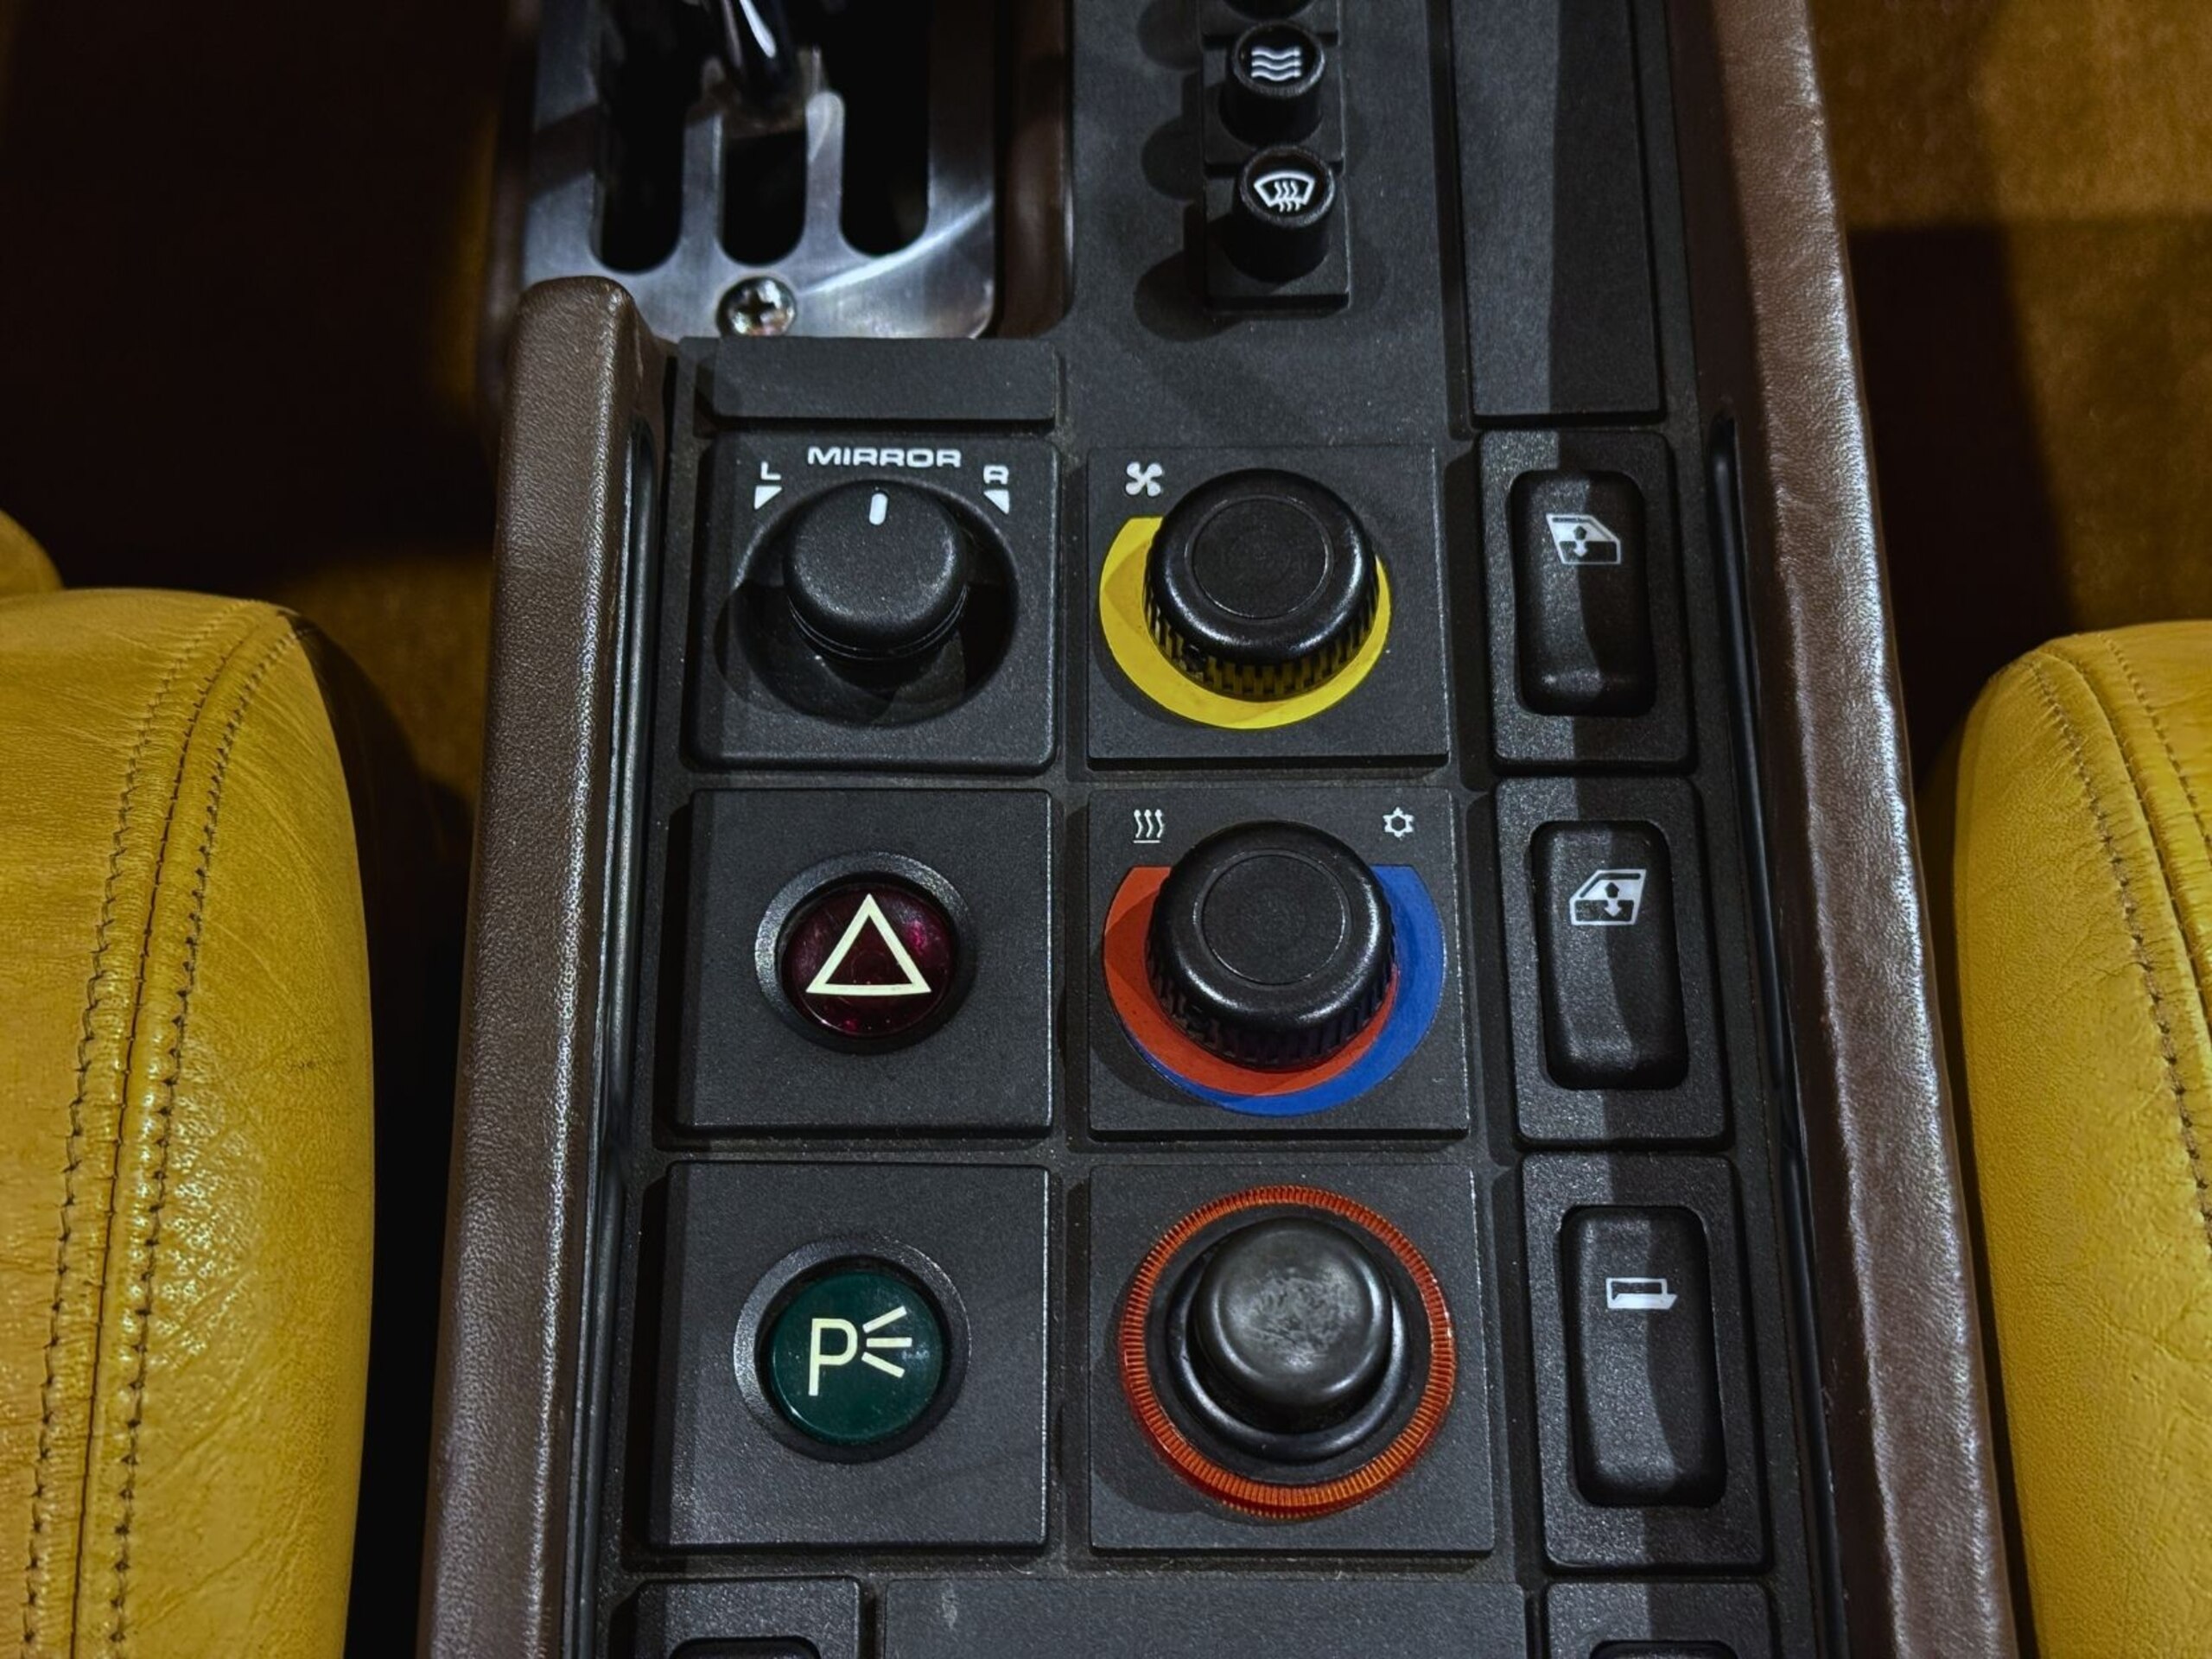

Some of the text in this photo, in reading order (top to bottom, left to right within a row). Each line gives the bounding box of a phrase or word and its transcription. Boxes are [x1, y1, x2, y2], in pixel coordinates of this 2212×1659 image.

[807, 446, 962, 468] MIRROR
[760, 461, 782, 480] L
[982, 465, 1009, 485] R
[808, 1318, 858, 1396] P
